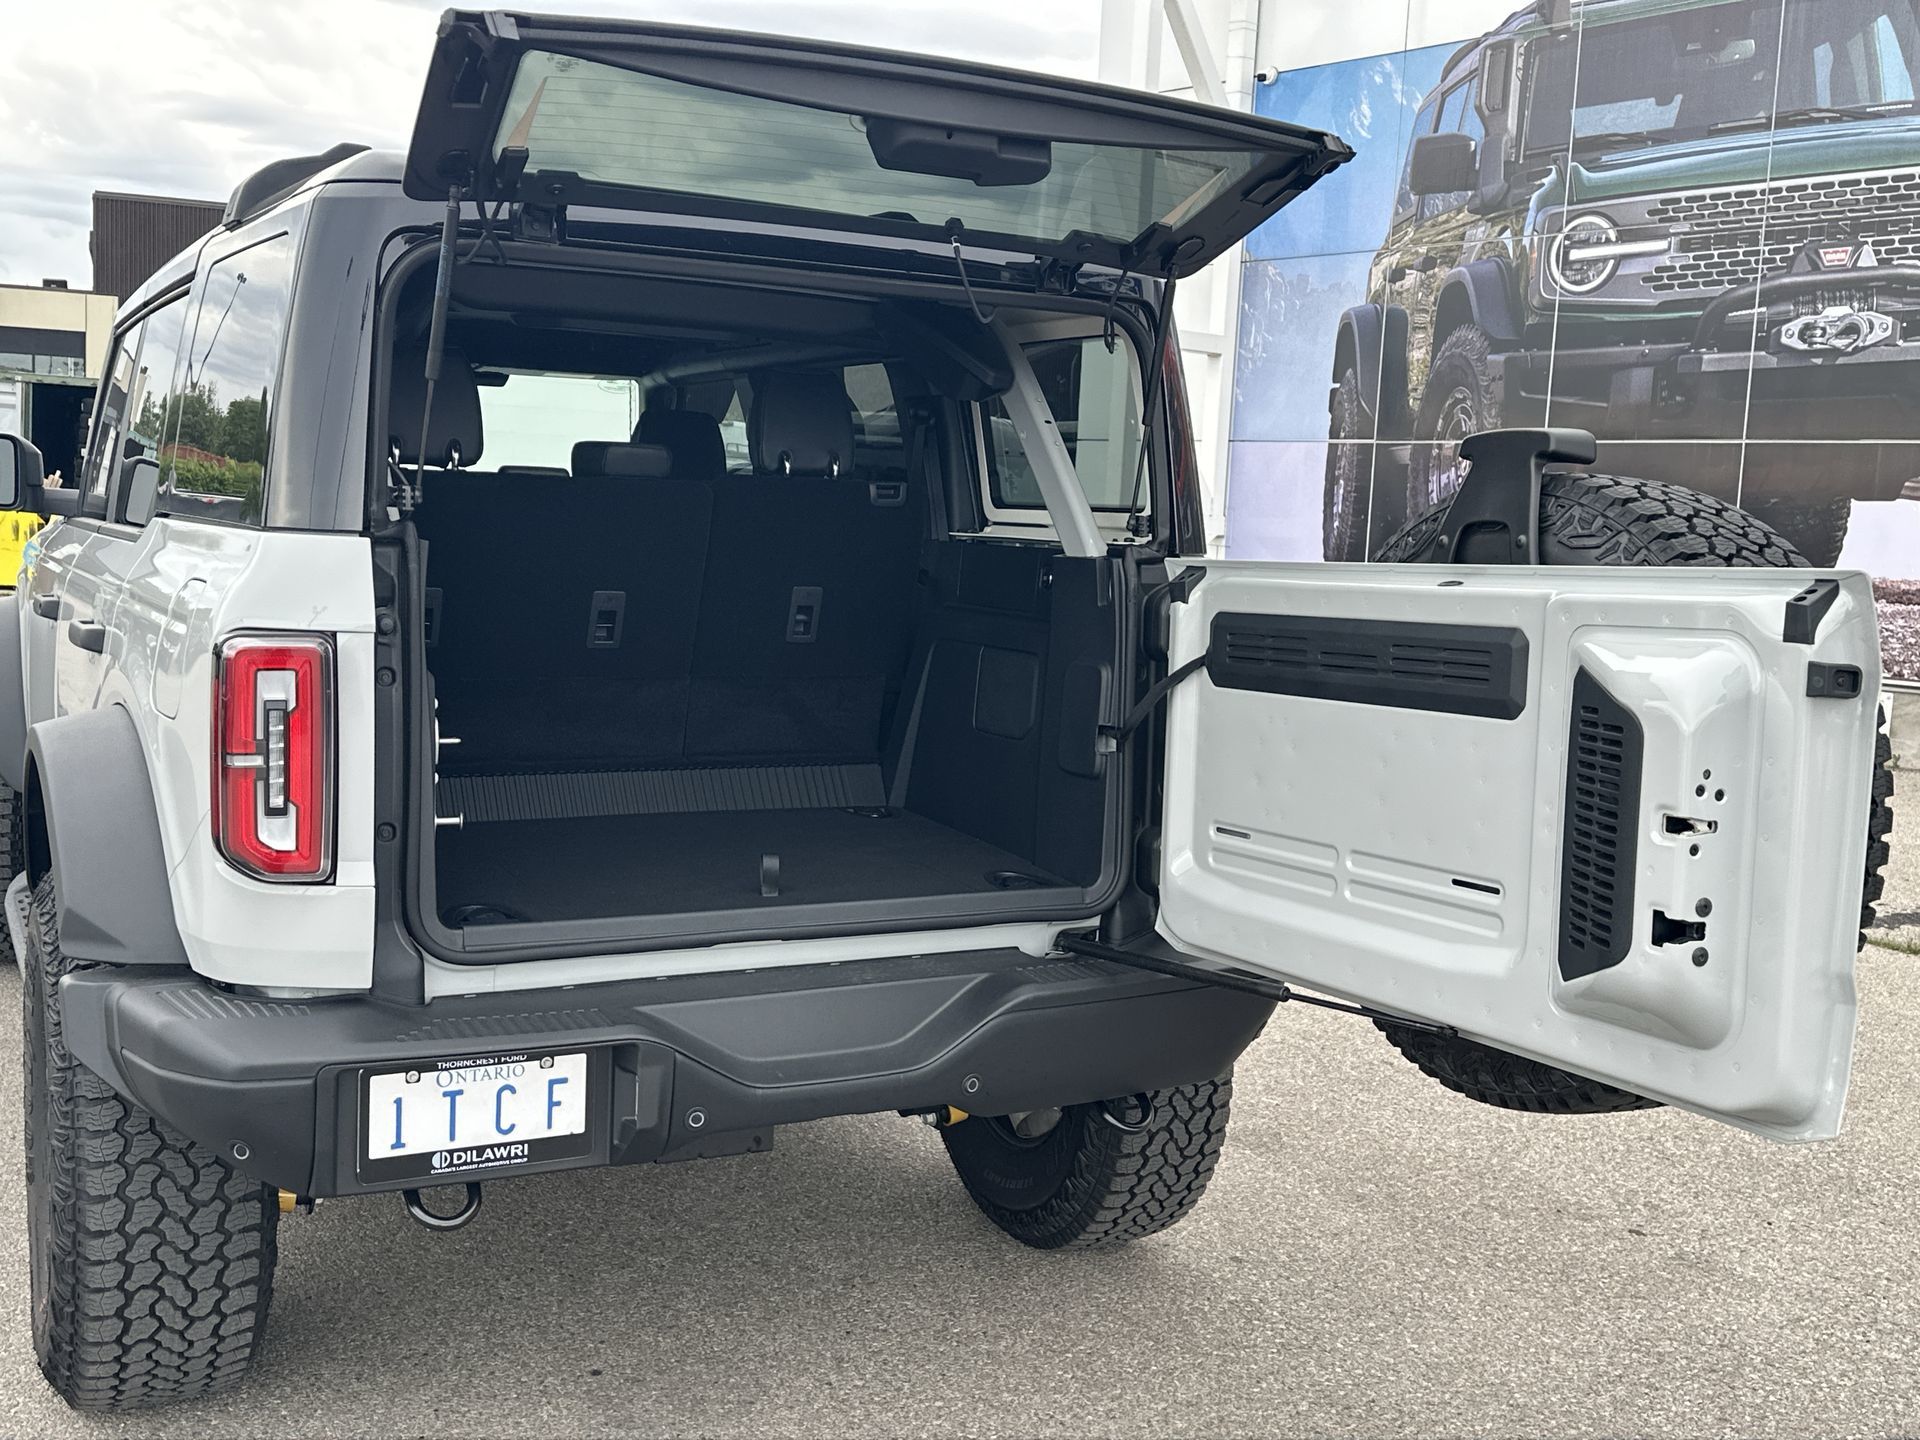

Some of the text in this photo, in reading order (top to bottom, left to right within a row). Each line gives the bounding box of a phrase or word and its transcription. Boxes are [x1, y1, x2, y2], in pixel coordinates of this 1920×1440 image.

[437, 1055, 528, 1070] THORNCREST FORD
[436, 1064, 525, 1088] ONTARIO
[453, 1143, 529, 1165] DILAWRI
